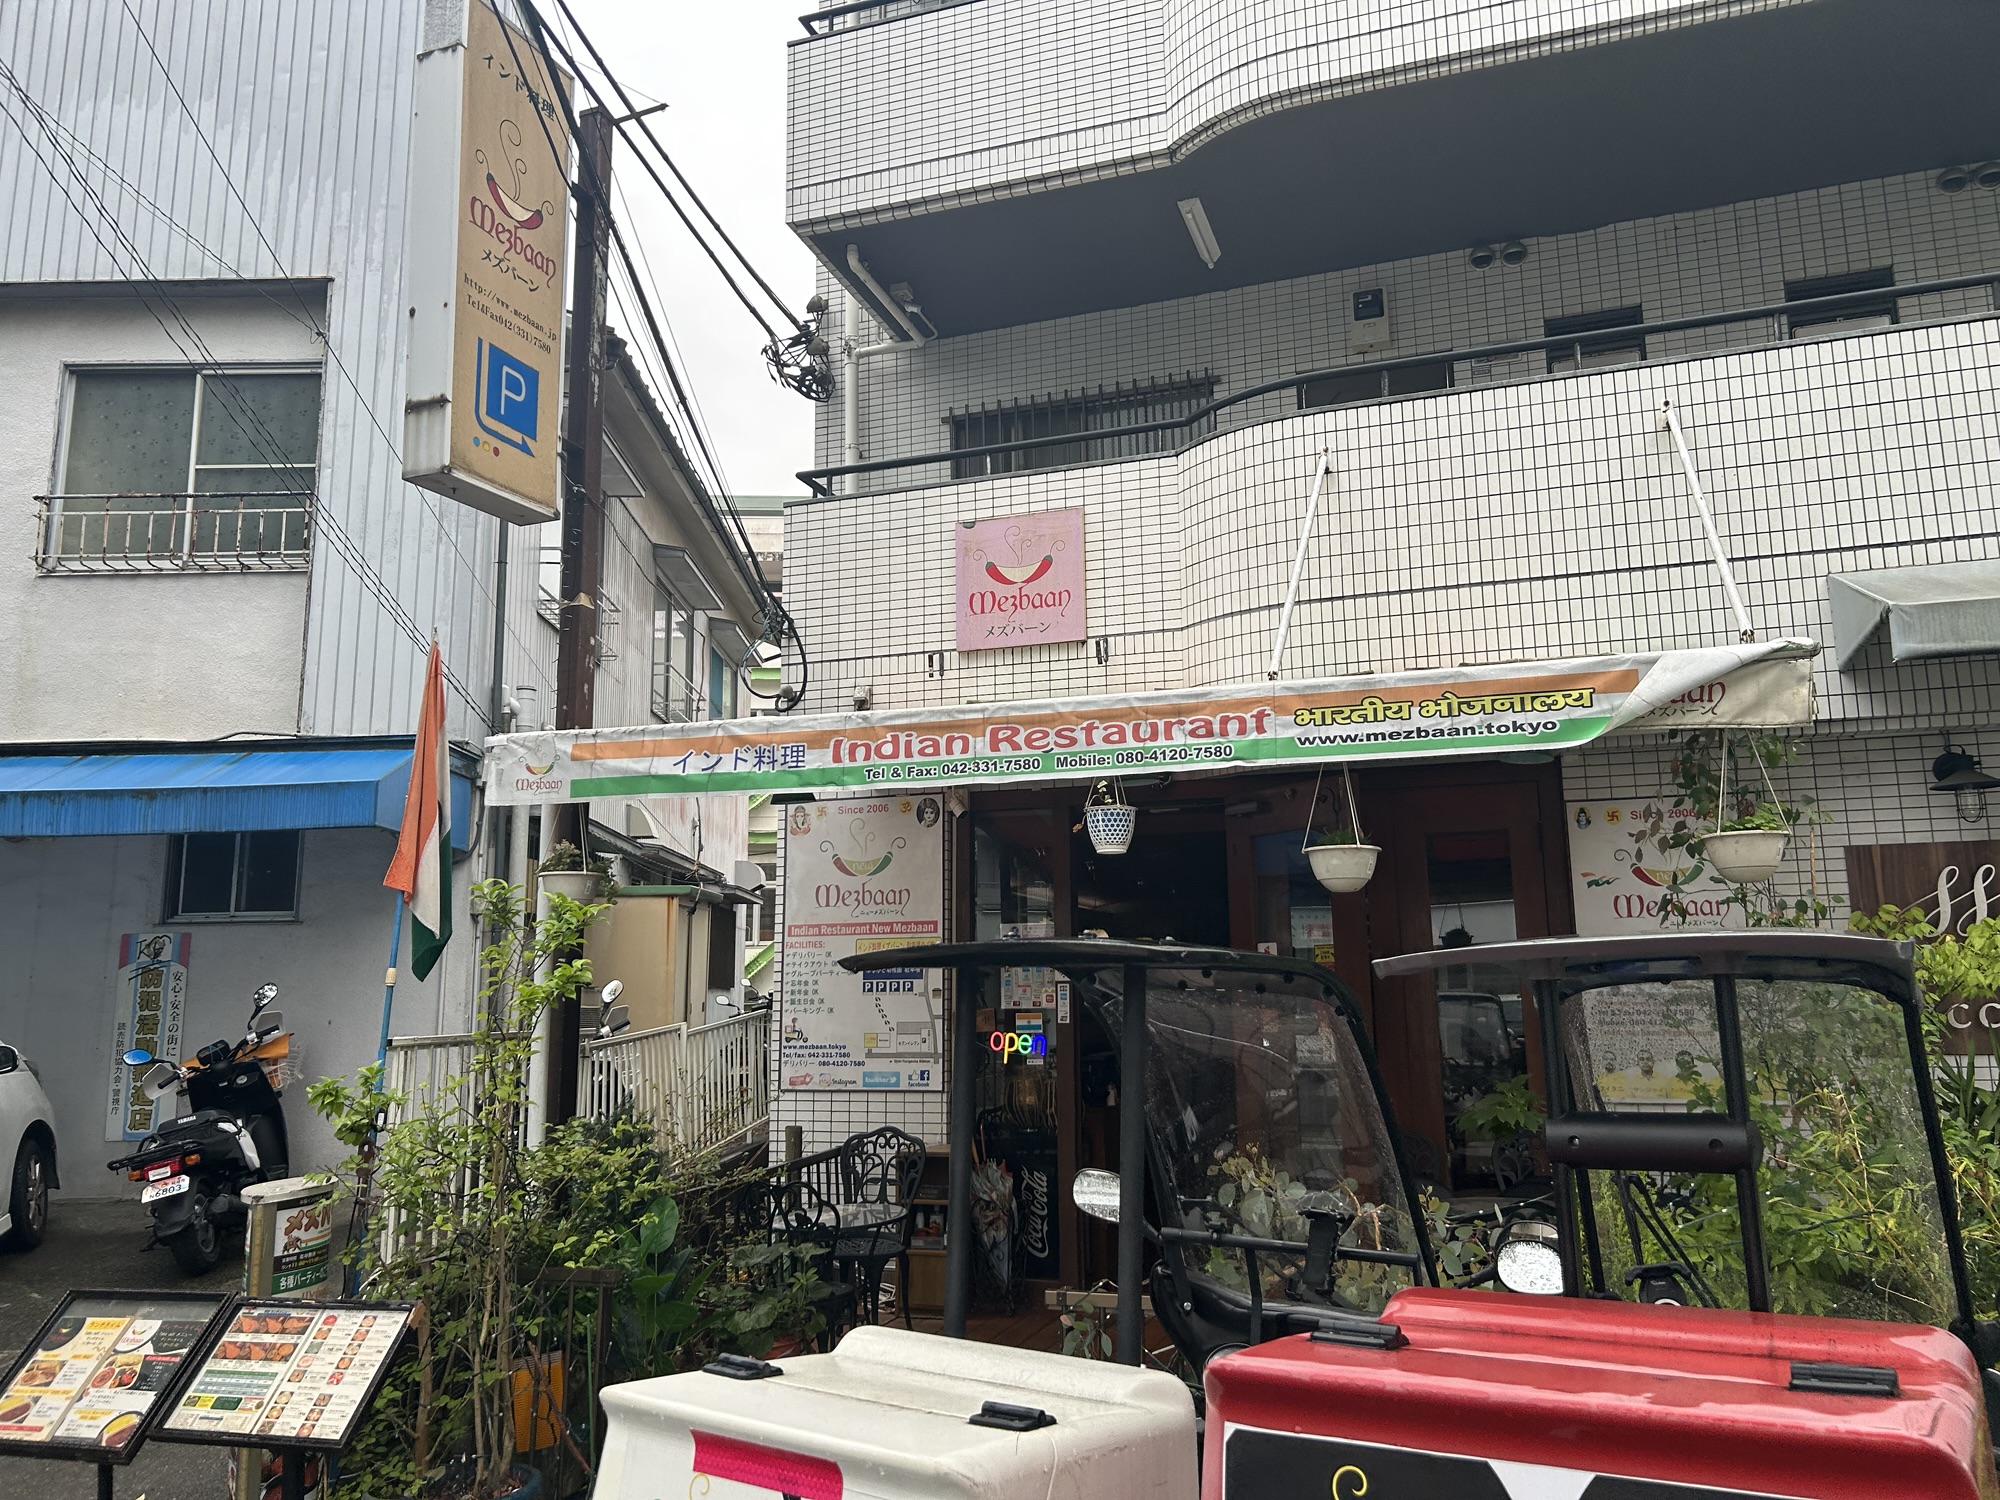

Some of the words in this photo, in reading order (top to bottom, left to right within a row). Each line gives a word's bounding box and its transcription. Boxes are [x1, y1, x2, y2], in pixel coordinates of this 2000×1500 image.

[469, 195, 557, 290] Mezbaan
[481, 249, 540, 293] メズバーン
[464, 272, 557, 342] http://www.mezbaan.jp
[500, 364, 527, 416] P
[968, 583, 1072, 623] Mezbaan
[984, 622, 1051, 639] メズバーン
[1294, 695, 1414, 727] भारतीय
[1418, 687, 1595, 719] भोजनालय
[831, 732, 970, 764] Indian
[988, 708, 1272, 753] Restaurant
[1296, 719, 1559, 747] www.mezbaan.tokyo
[673, 744, 806, 775] インド料理
[865, 768, 884, 780] Tel
[890, 767, 902, 778] &
[907, 764, 938, 778] Fax:
[942, 757, 1041, 775] 042-331-7580
[1056, 754, 1110, 768] Mobile:
[1115, 744, 1233, 764] 080-4120-7580
[515, 777, 563, 795] Mezbaan
[838, 805, 864, 815] Since
[867, 804, 889, 814] 2006
[815, 878, 911, 918] Mezbaan
[786, 940, 826, 949] FACILITIES:
[791, 925, 819, 935] Indian
[821, 924, 870, 935] Restaurant
[872, 923, 891, 933] New
[893, 922, 934, 932] Mezbaan
[783, 1043, 847, 1051] www.mezbaan.tokyo
[808, 1051, 851, 1059] 042-331-7580
[990, 1031, 1047, 1065] open
[155, 1184, 182, 1197] 6803
